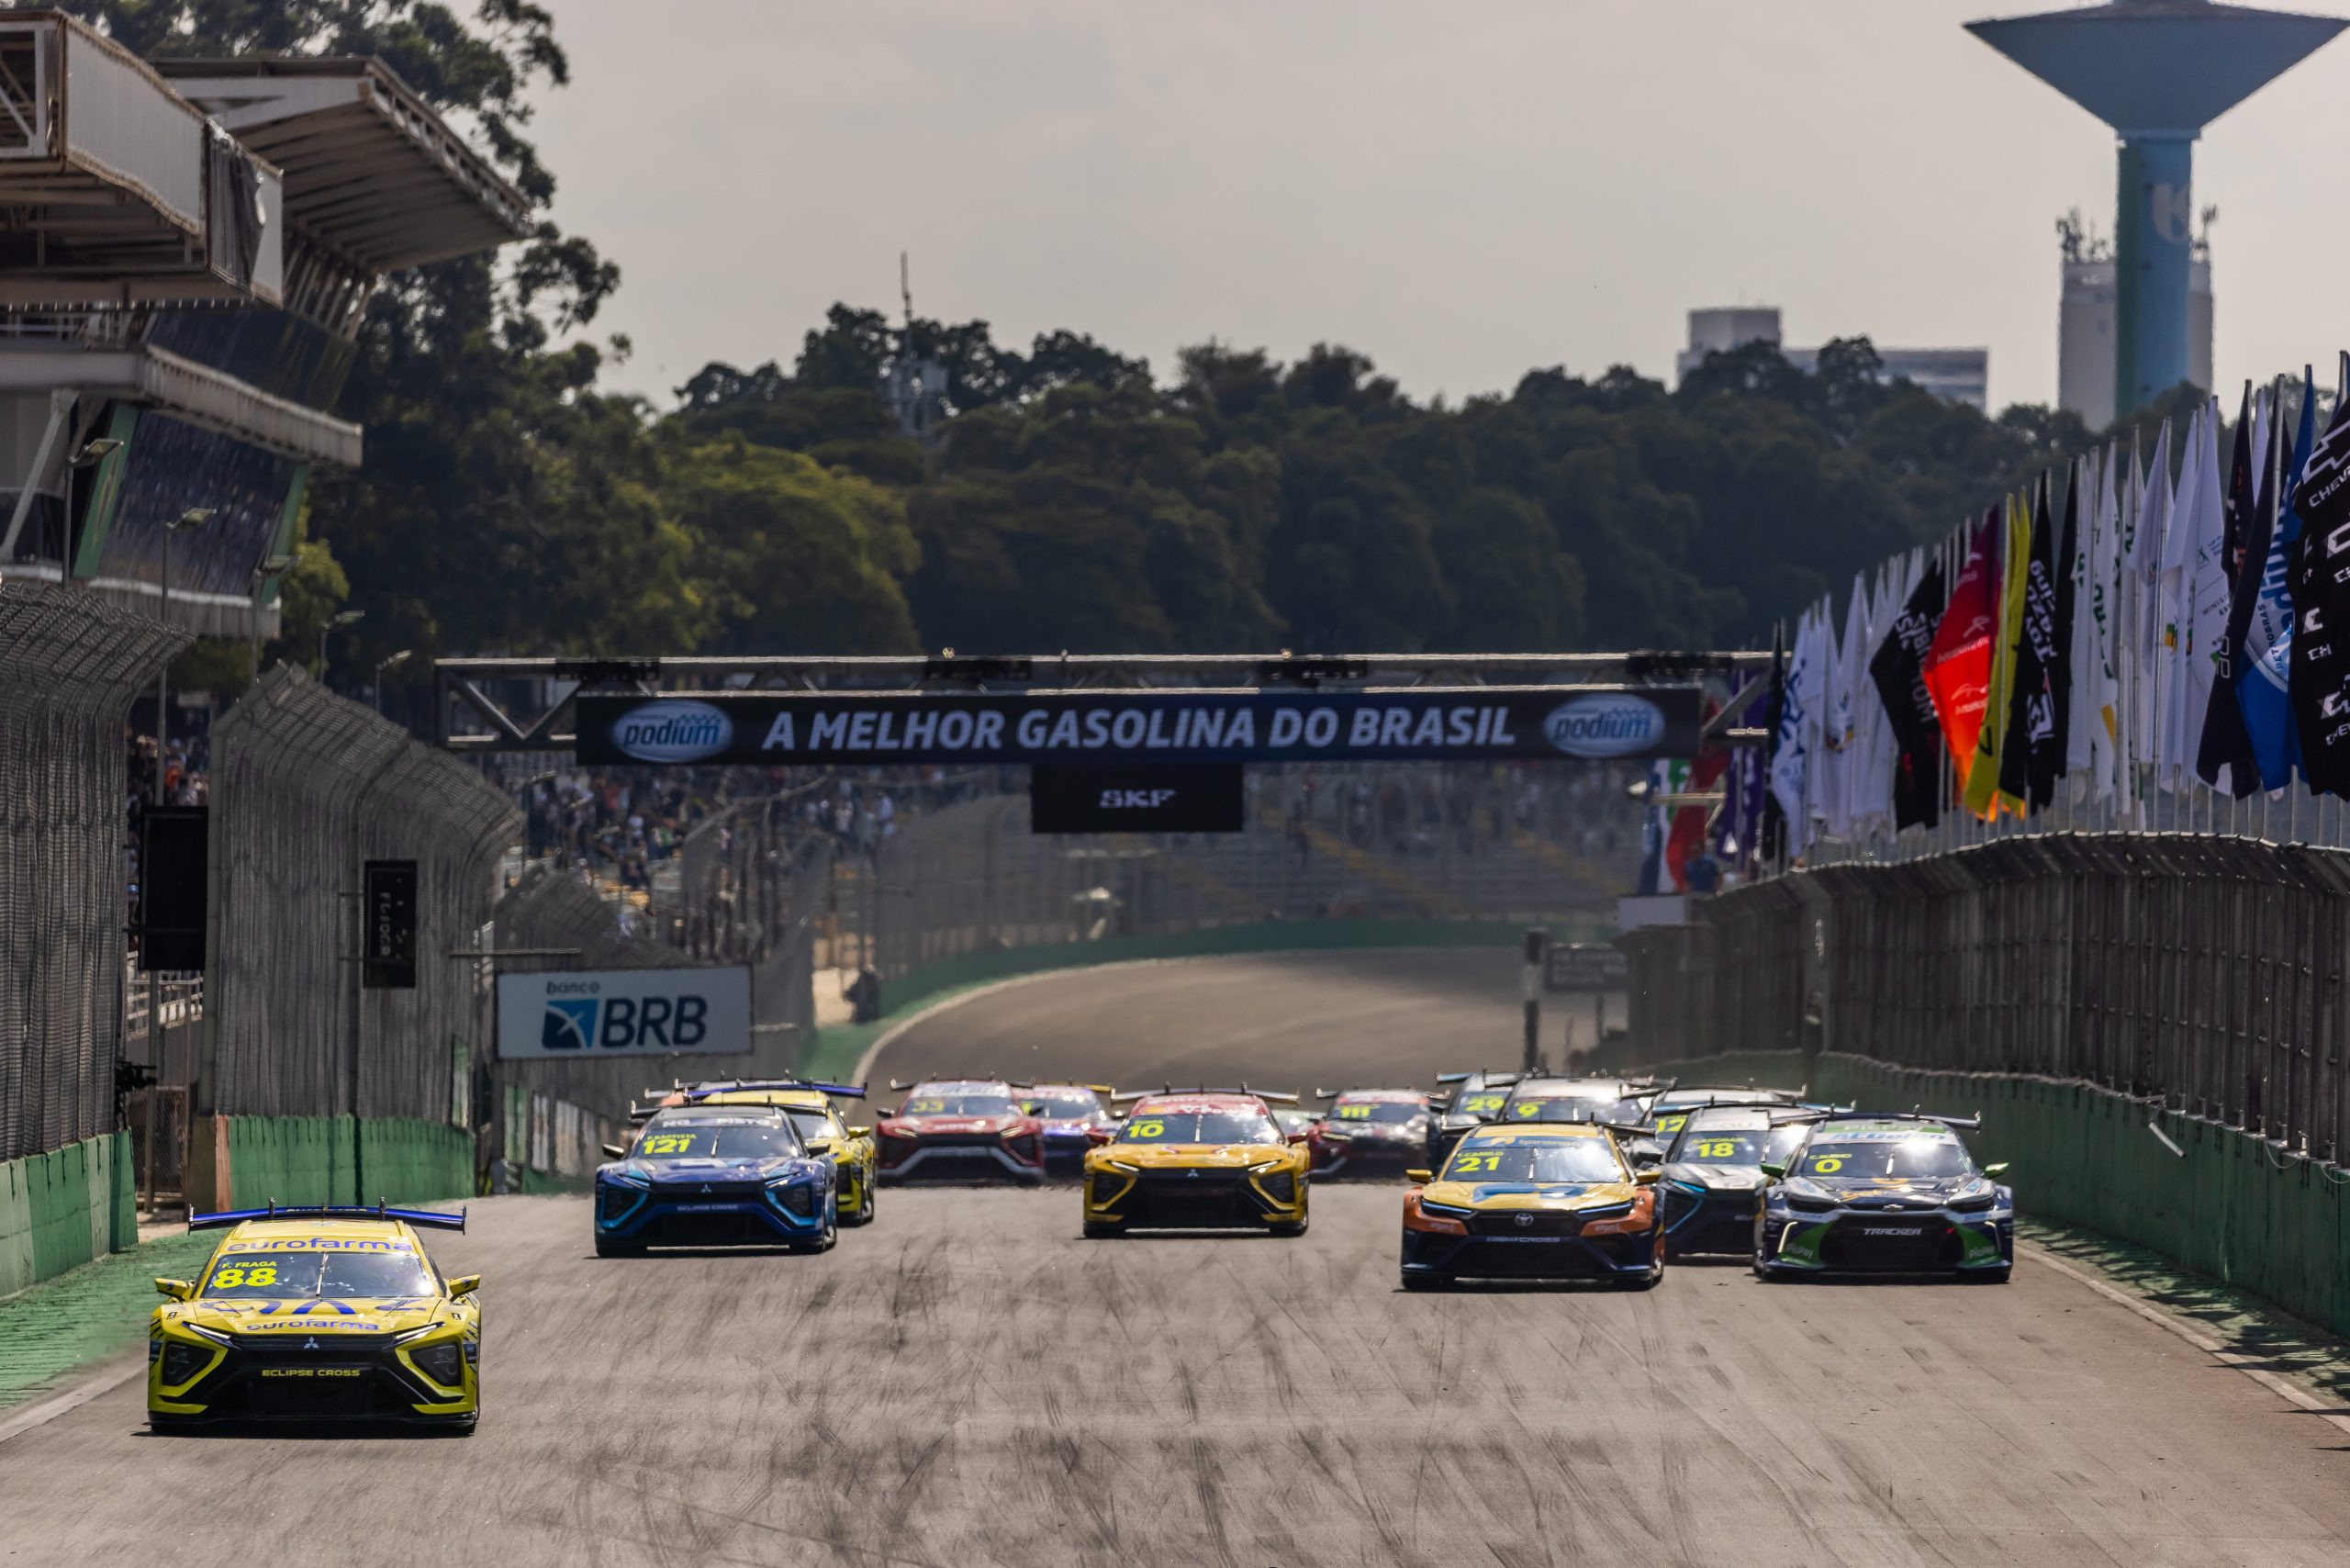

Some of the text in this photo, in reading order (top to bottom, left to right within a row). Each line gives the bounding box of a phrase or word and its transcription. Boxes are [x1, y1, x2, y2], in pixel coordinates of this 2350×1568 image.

[624, 719, 721, 747] podium
[762, 706, 1516, 750] A MELHOR GASOLINA DO BRASIL
[1554, 711, 1652, 742] podium
[1099, 790, 1176, 808] SKF
[546, 980, 601, 994] banco
[600, 994, 708, 1047] BRB
[1516, 1103, 1539, 1118] 9
[1127, 1124, 1165, 1138] 10
[643, 1138, 691, 1155] 121
[1697, 1142, 1735, 1158] 18
[1454, 1157, 1500, 1172] 21
[1814, 1159, 1842, 1173] 0
[1863, 1227, 1922, 1236] TRACKER
[227, 1238, 413, 1252] eurofarma
[235, 1260, 277, 1269] FRAGA
[213, 1267, 278, 1289] 88
[246, 1318, 379, 1331] eurofarma
[262, 1369, 361, 1377] ECLIPSE CROSS
